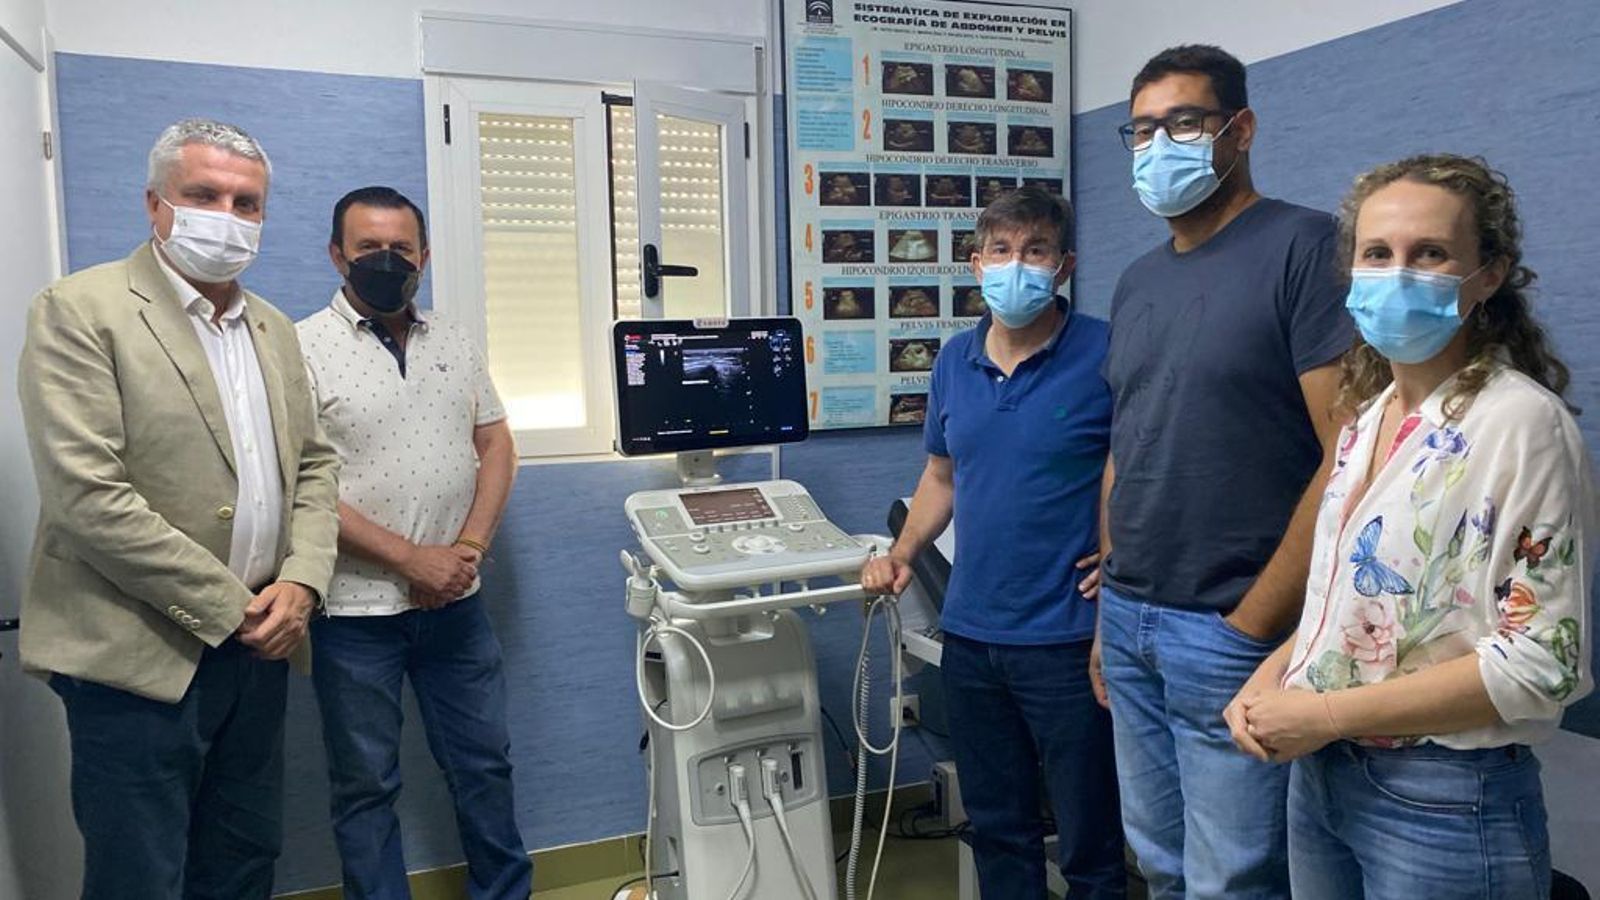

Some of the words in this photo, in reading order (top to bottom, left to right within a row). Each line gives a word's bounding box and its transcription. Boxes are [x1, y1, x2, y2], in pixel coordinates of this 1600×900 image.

[854, 3, 940, 17] SISTEMÁTICA
[943, 10, 959, 19] DE
[963, 12, 1047, 26] EXPLORACIÓN
[1051, 19, 1066, 27] EN
[854, 14, 927, 27] ECOGRAFÍA
[931, 20, 947, 28] DE
[951, 21, 1013, 33] ABDOMEN
[1017, 26, 1024, 34] Y
[1028, 28, 1066, 38] PELVIS
[904, 42, 959, 53] EPIGASTRIO
[863, 53, 869, 86] 1
[863, 108, 871, 140] 2
[804, 163, 813, 195] 3
[879, 210, 941, 220] EPIGASTRIO
[805, 223, 812, 253] 4
[841, 265, 906, 275] HIPOCONDRIO
[805, 281, 813, 310] 5
[901, 320, 933, 329] PELVIS
[806, 336, 814, 364] 6
[810, 391, 818, 421] 7
